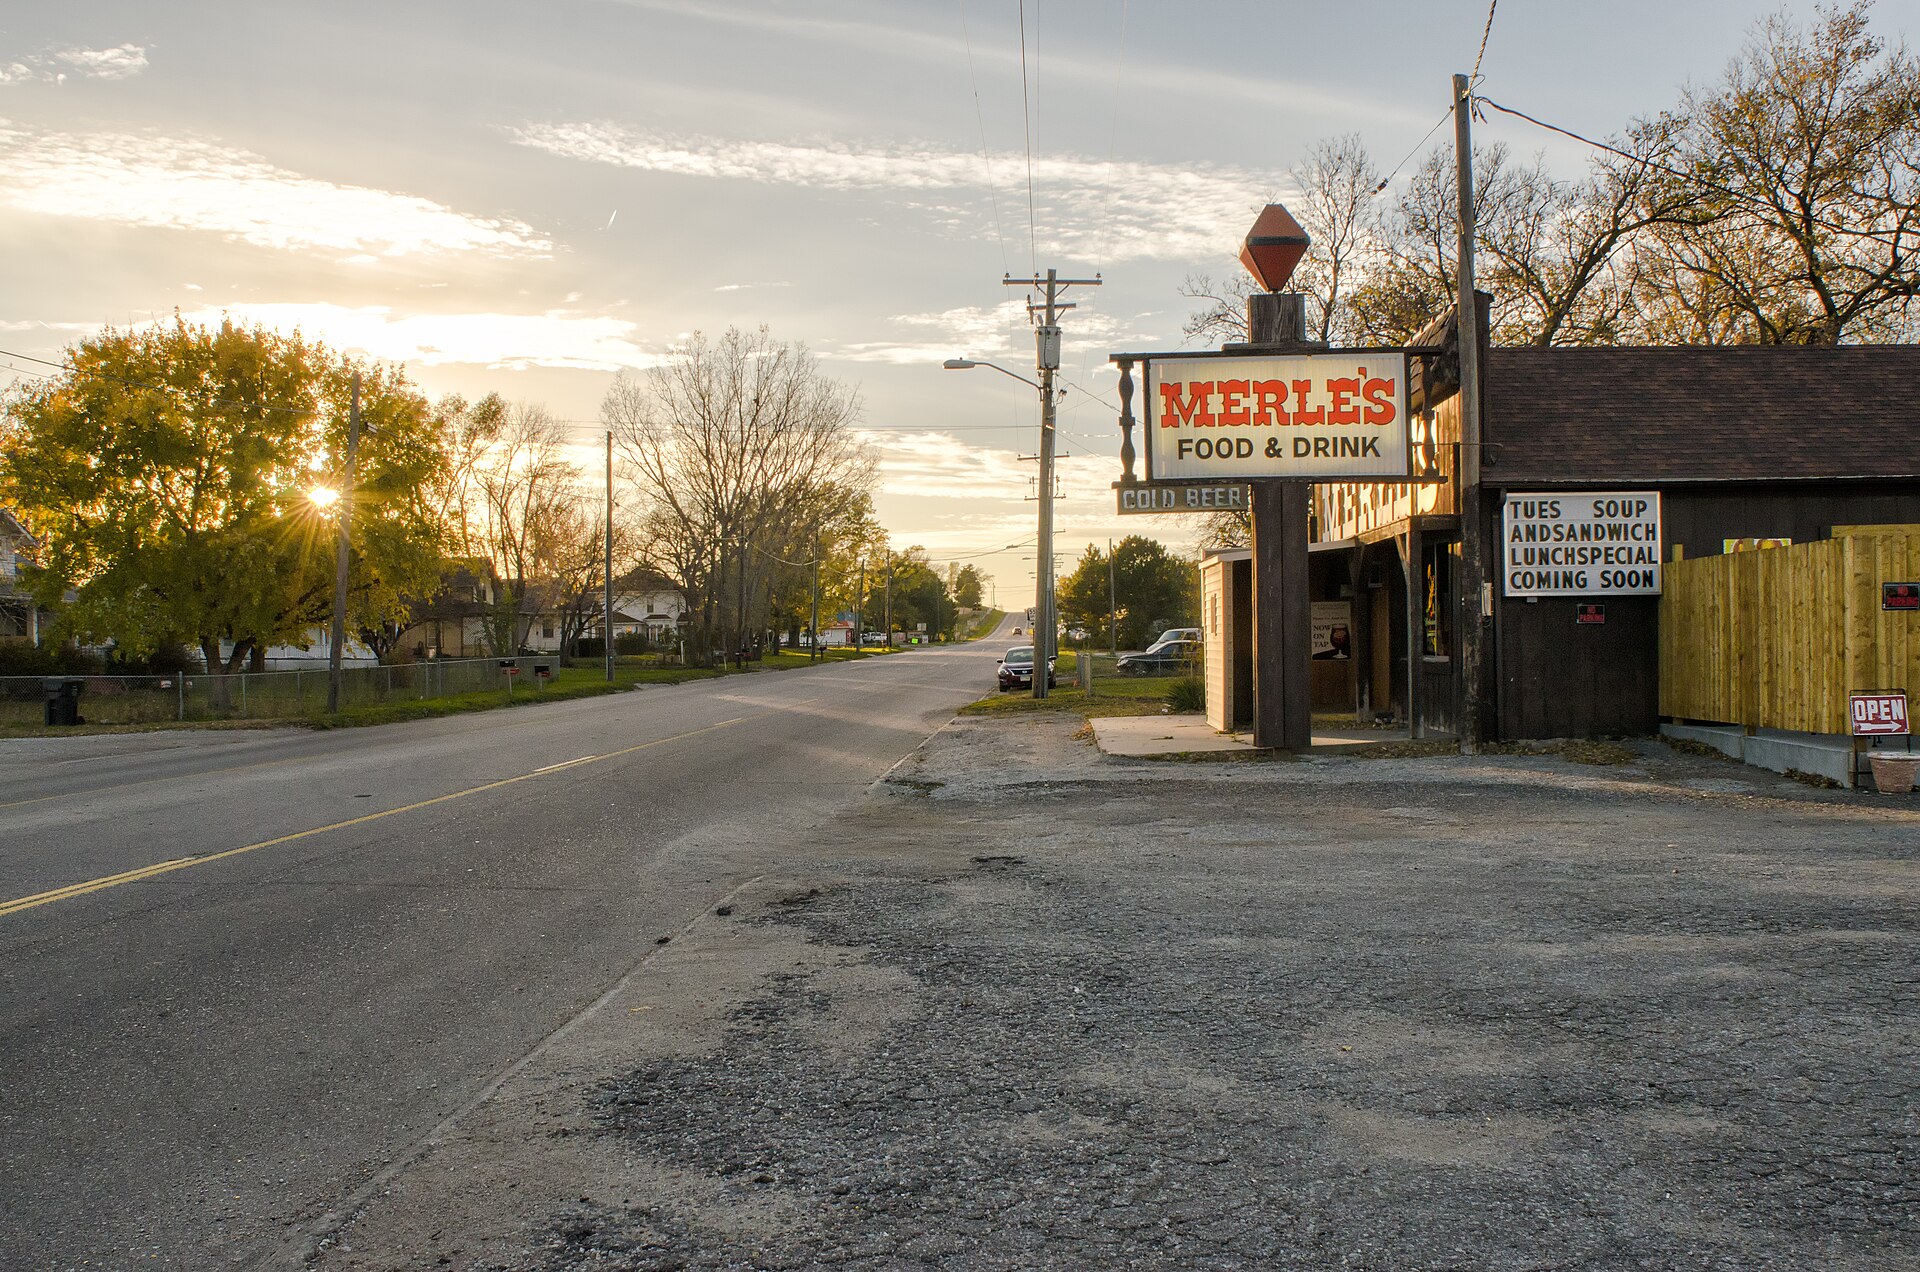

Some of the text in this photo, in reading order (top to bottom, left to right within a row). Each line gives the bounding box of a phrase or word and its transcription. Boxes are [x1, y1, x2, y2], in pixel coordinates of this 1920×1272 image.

[1159, 367, 1396, 428] MERLE'S
[1177, 436, 1381, 460] FOOD & DRINK
[1186, 488, 1242, 508] BEER
[1510, 500, 1647, 519] TUES SOUP
[1510, 570, 1654, 589] COMING SOON
[1854, 699, 1904, 721] OPEN
